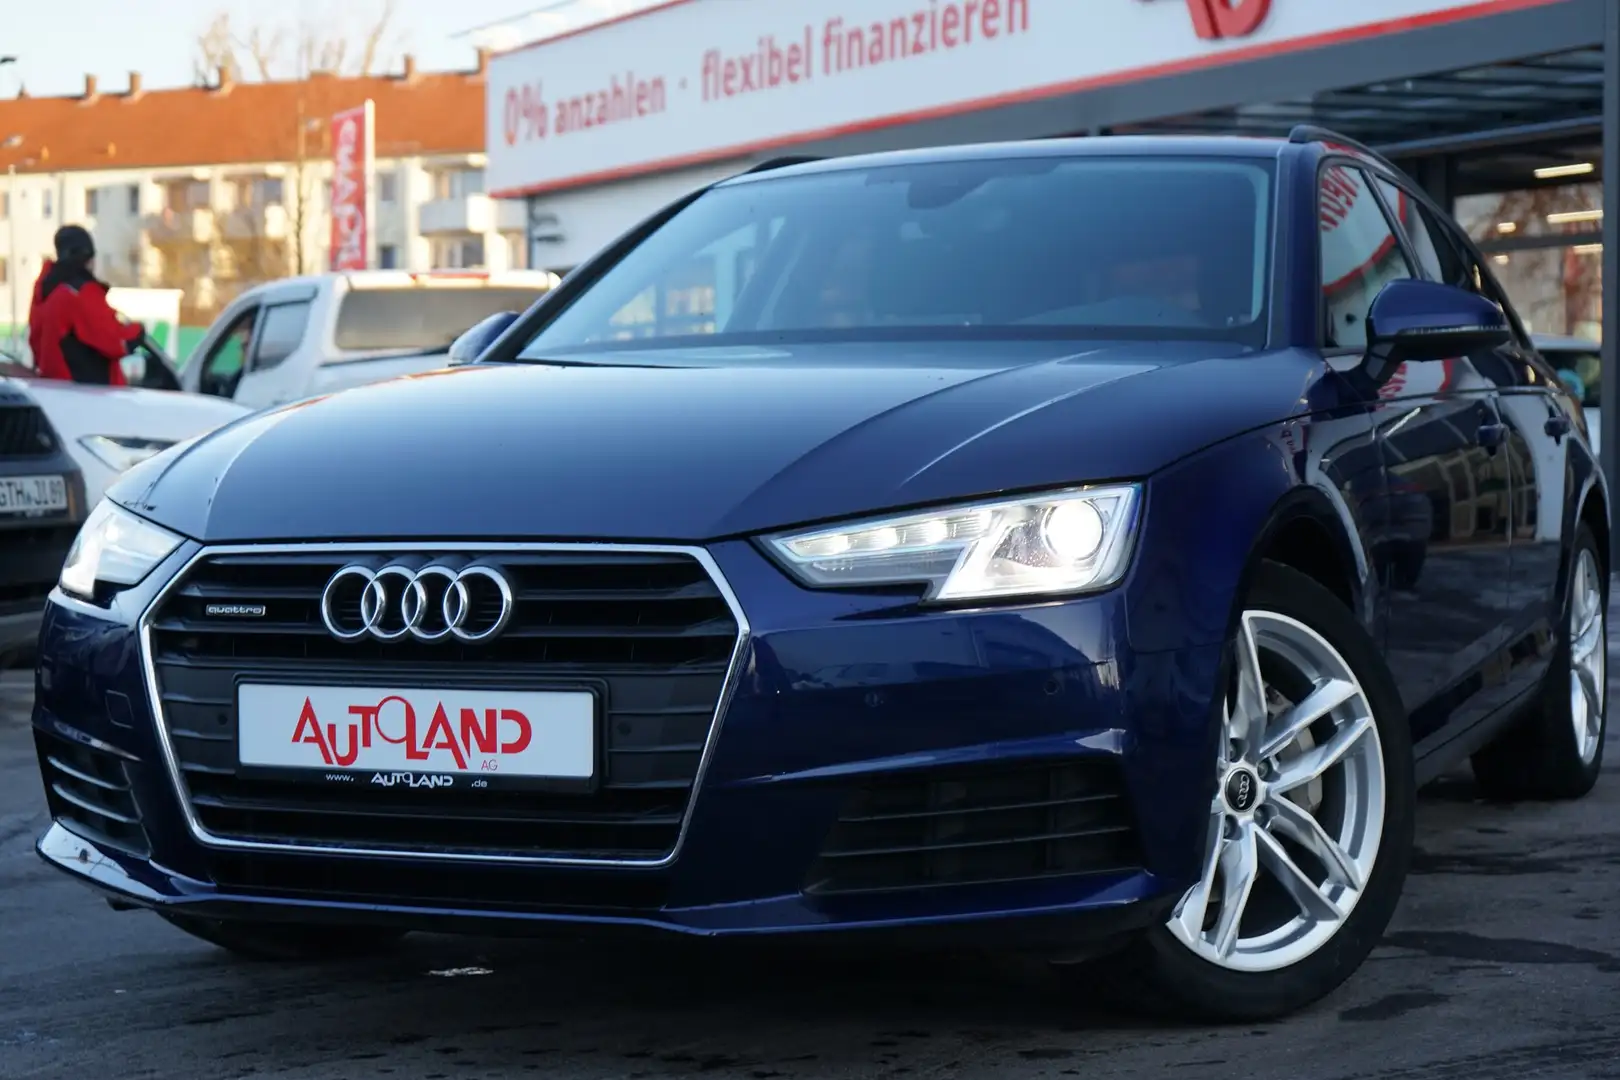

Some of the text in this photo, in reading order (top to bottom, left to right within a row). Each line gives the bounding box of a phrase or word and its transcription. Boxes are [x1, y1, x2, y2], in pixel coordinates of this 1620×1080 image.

[504, 0, 1029, 144] 0% anzahlen flexibel finanzieren
[208, 605, 262, 615] quattro
[291, 696, 532, 769] AUTOLAND
[480, 758, 498, 772] AG
[325, 772, 488, 788] www. AUTOLAND .de
